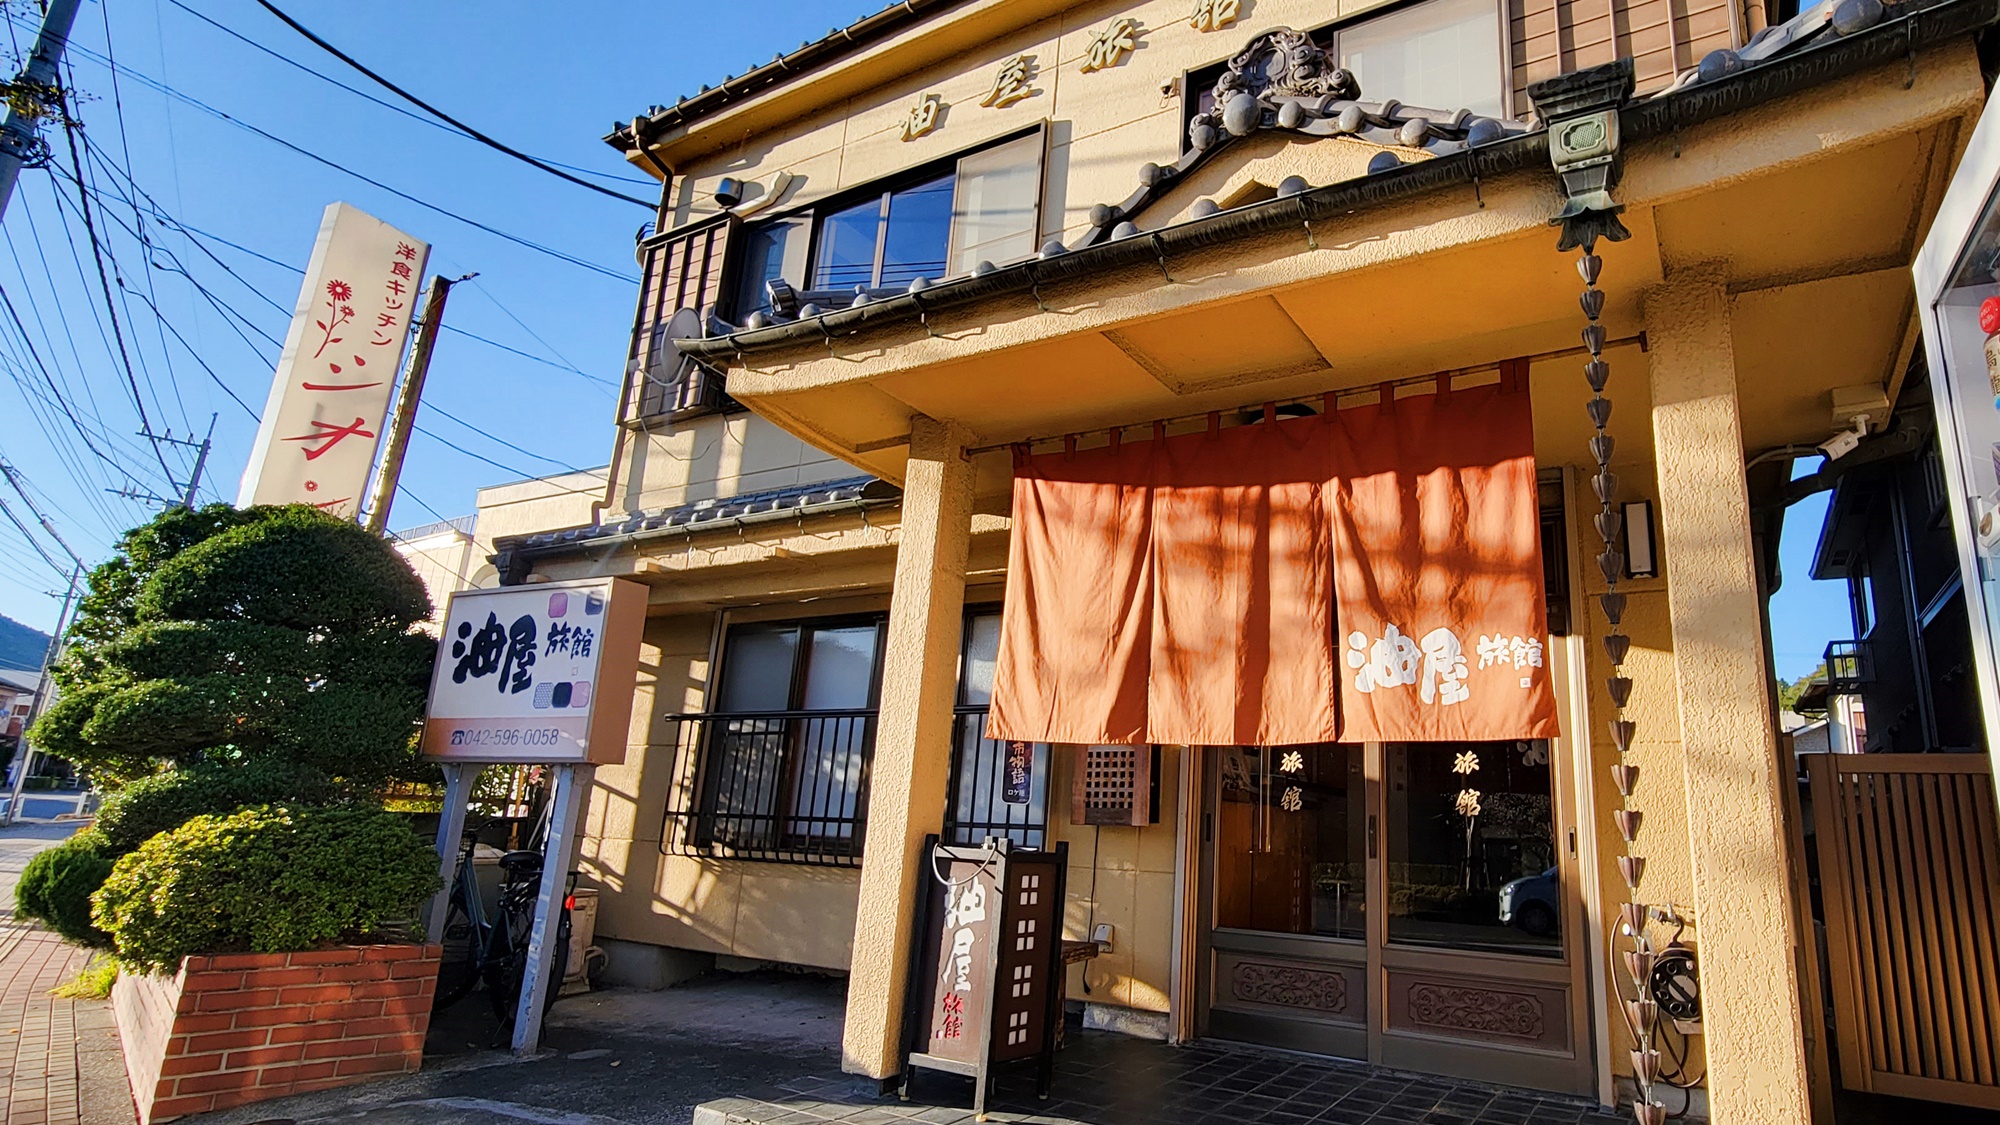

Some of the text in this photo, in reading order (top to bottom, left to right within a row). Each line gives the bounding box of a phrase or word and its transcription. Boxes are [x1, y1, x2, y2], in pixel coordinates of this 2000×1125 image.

[371, 241, 417, 346] 洋食キッチン
[452, 611, 594, 694] 油屋 旅館
[1347, 622, 1543, 706] 油屋 旅館
[464, 728, 559, 746] 042-596-0058
[941, 875, 987, 1039] 油屋 旅館
